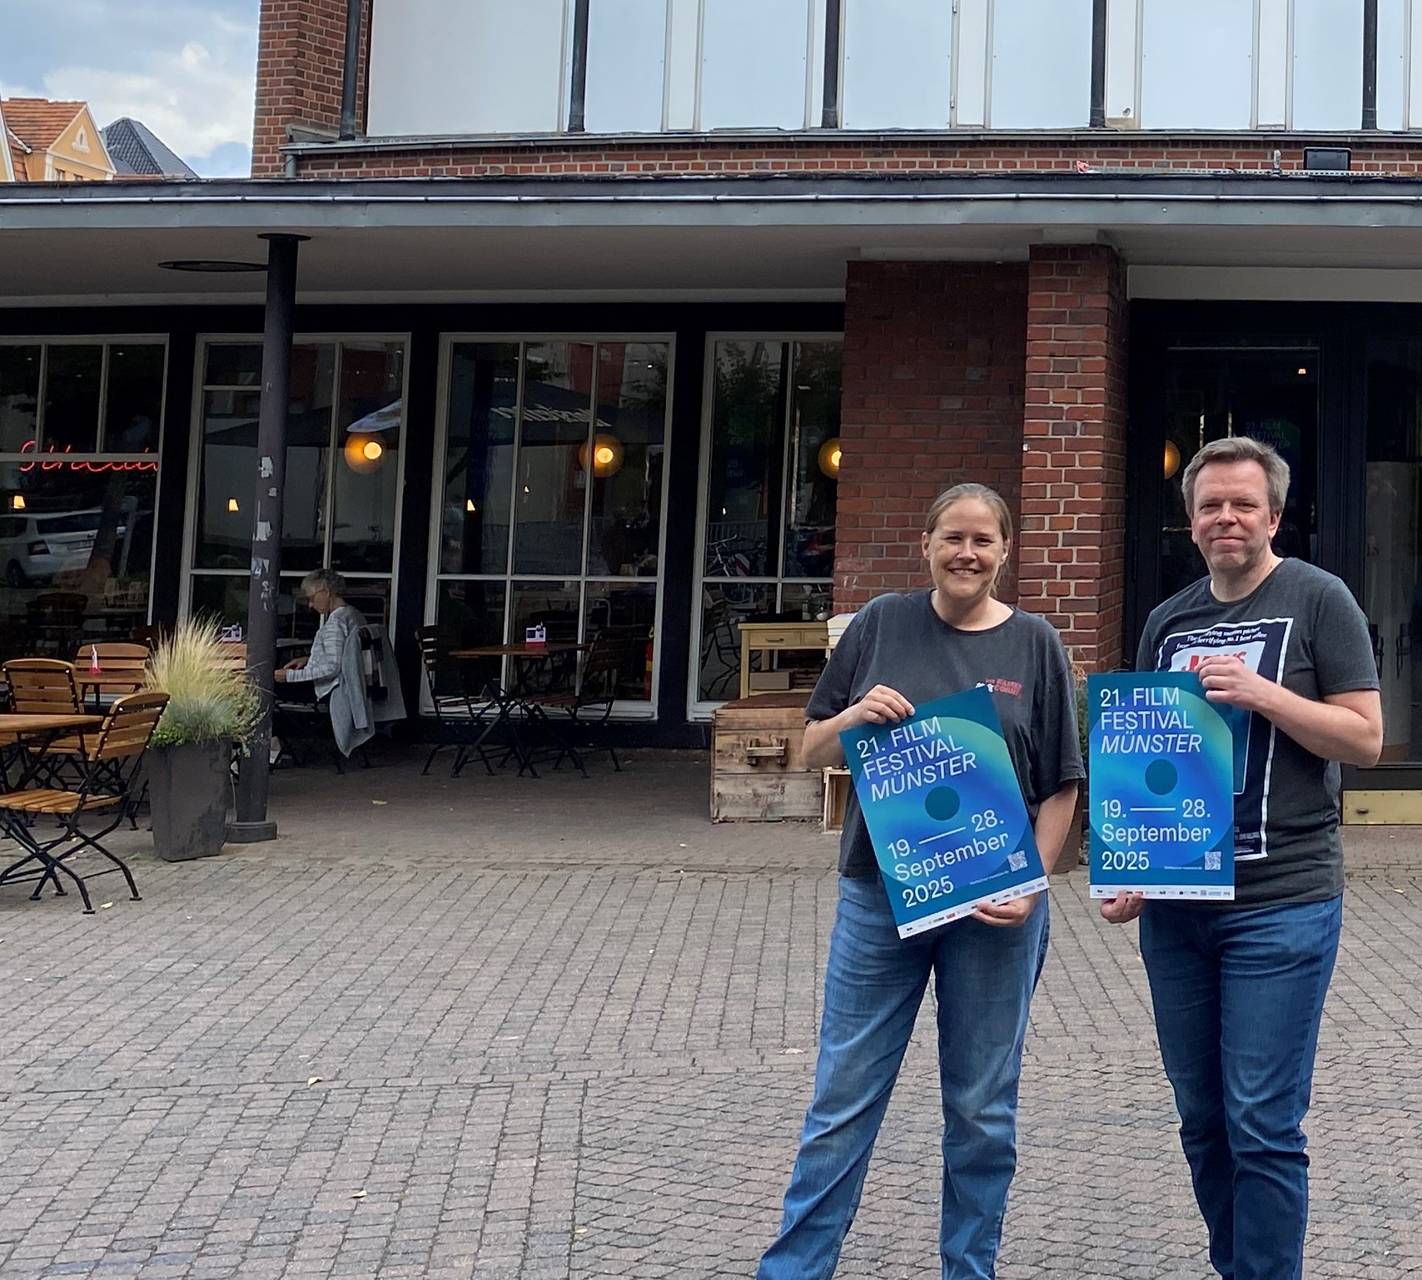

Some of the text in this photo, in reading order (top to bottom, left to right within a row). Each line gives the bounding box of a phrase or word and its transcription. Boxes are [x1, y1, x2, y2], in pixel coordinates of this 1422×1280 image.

[1100, 687, 1180, 707] 21. FILM
[1101, 710, 1194, 730] FESTIVAL
[856, 715, 942, 759] 21. FILM
[1101, 730, 1202, 754] MÜNSTER
[862, 735, 964, 780] FESTIVAL
[871, 752, 977, 802] MÜNSTER
[1101, 799, 1211, 818] 19. 28.
[887, 809, 1005, 860] 19. 28.
[1101, 822, 1212, 847] September
[894, 832, 1009, 881] September
[1101, 851, 1150, 870] 2025
[902, 875, 954, 908] 2025
